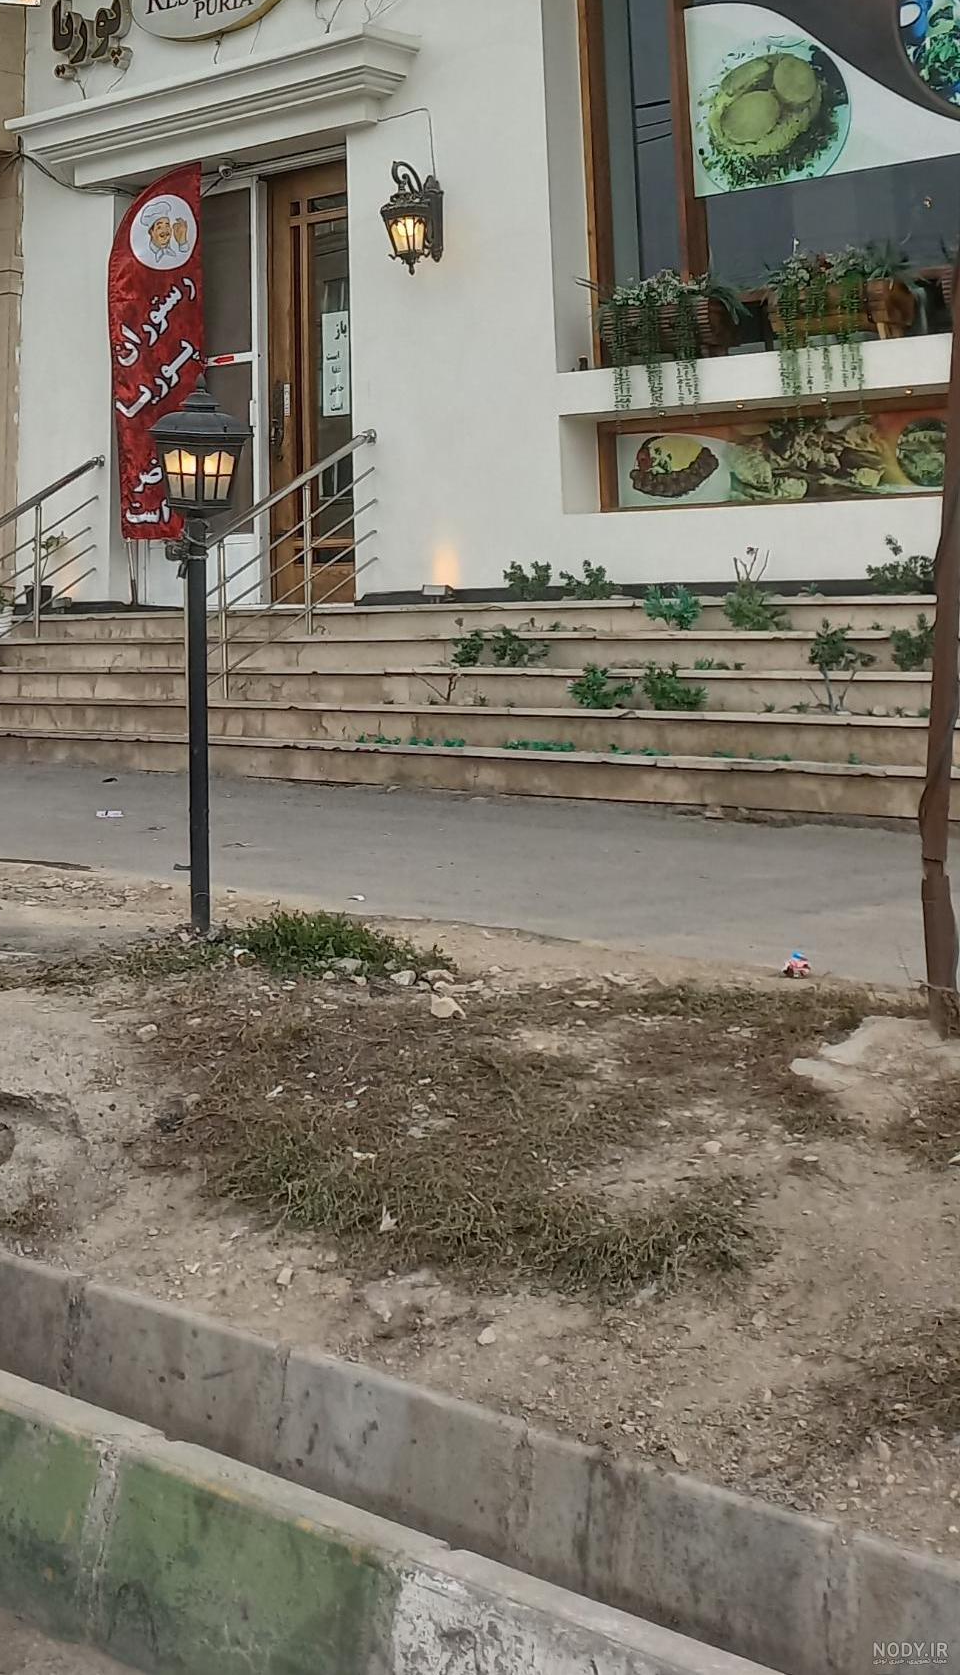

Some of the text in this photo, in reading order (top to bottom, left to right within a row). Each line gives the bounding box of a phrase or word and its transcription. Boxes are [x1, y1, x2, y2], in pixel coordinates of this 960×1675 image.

[115, 276, 198, 367] رستوران
[115, 339, 200, 419] پوریا
[133, 457, 163, 493] ضر
[125, 499, 171, 524] است
